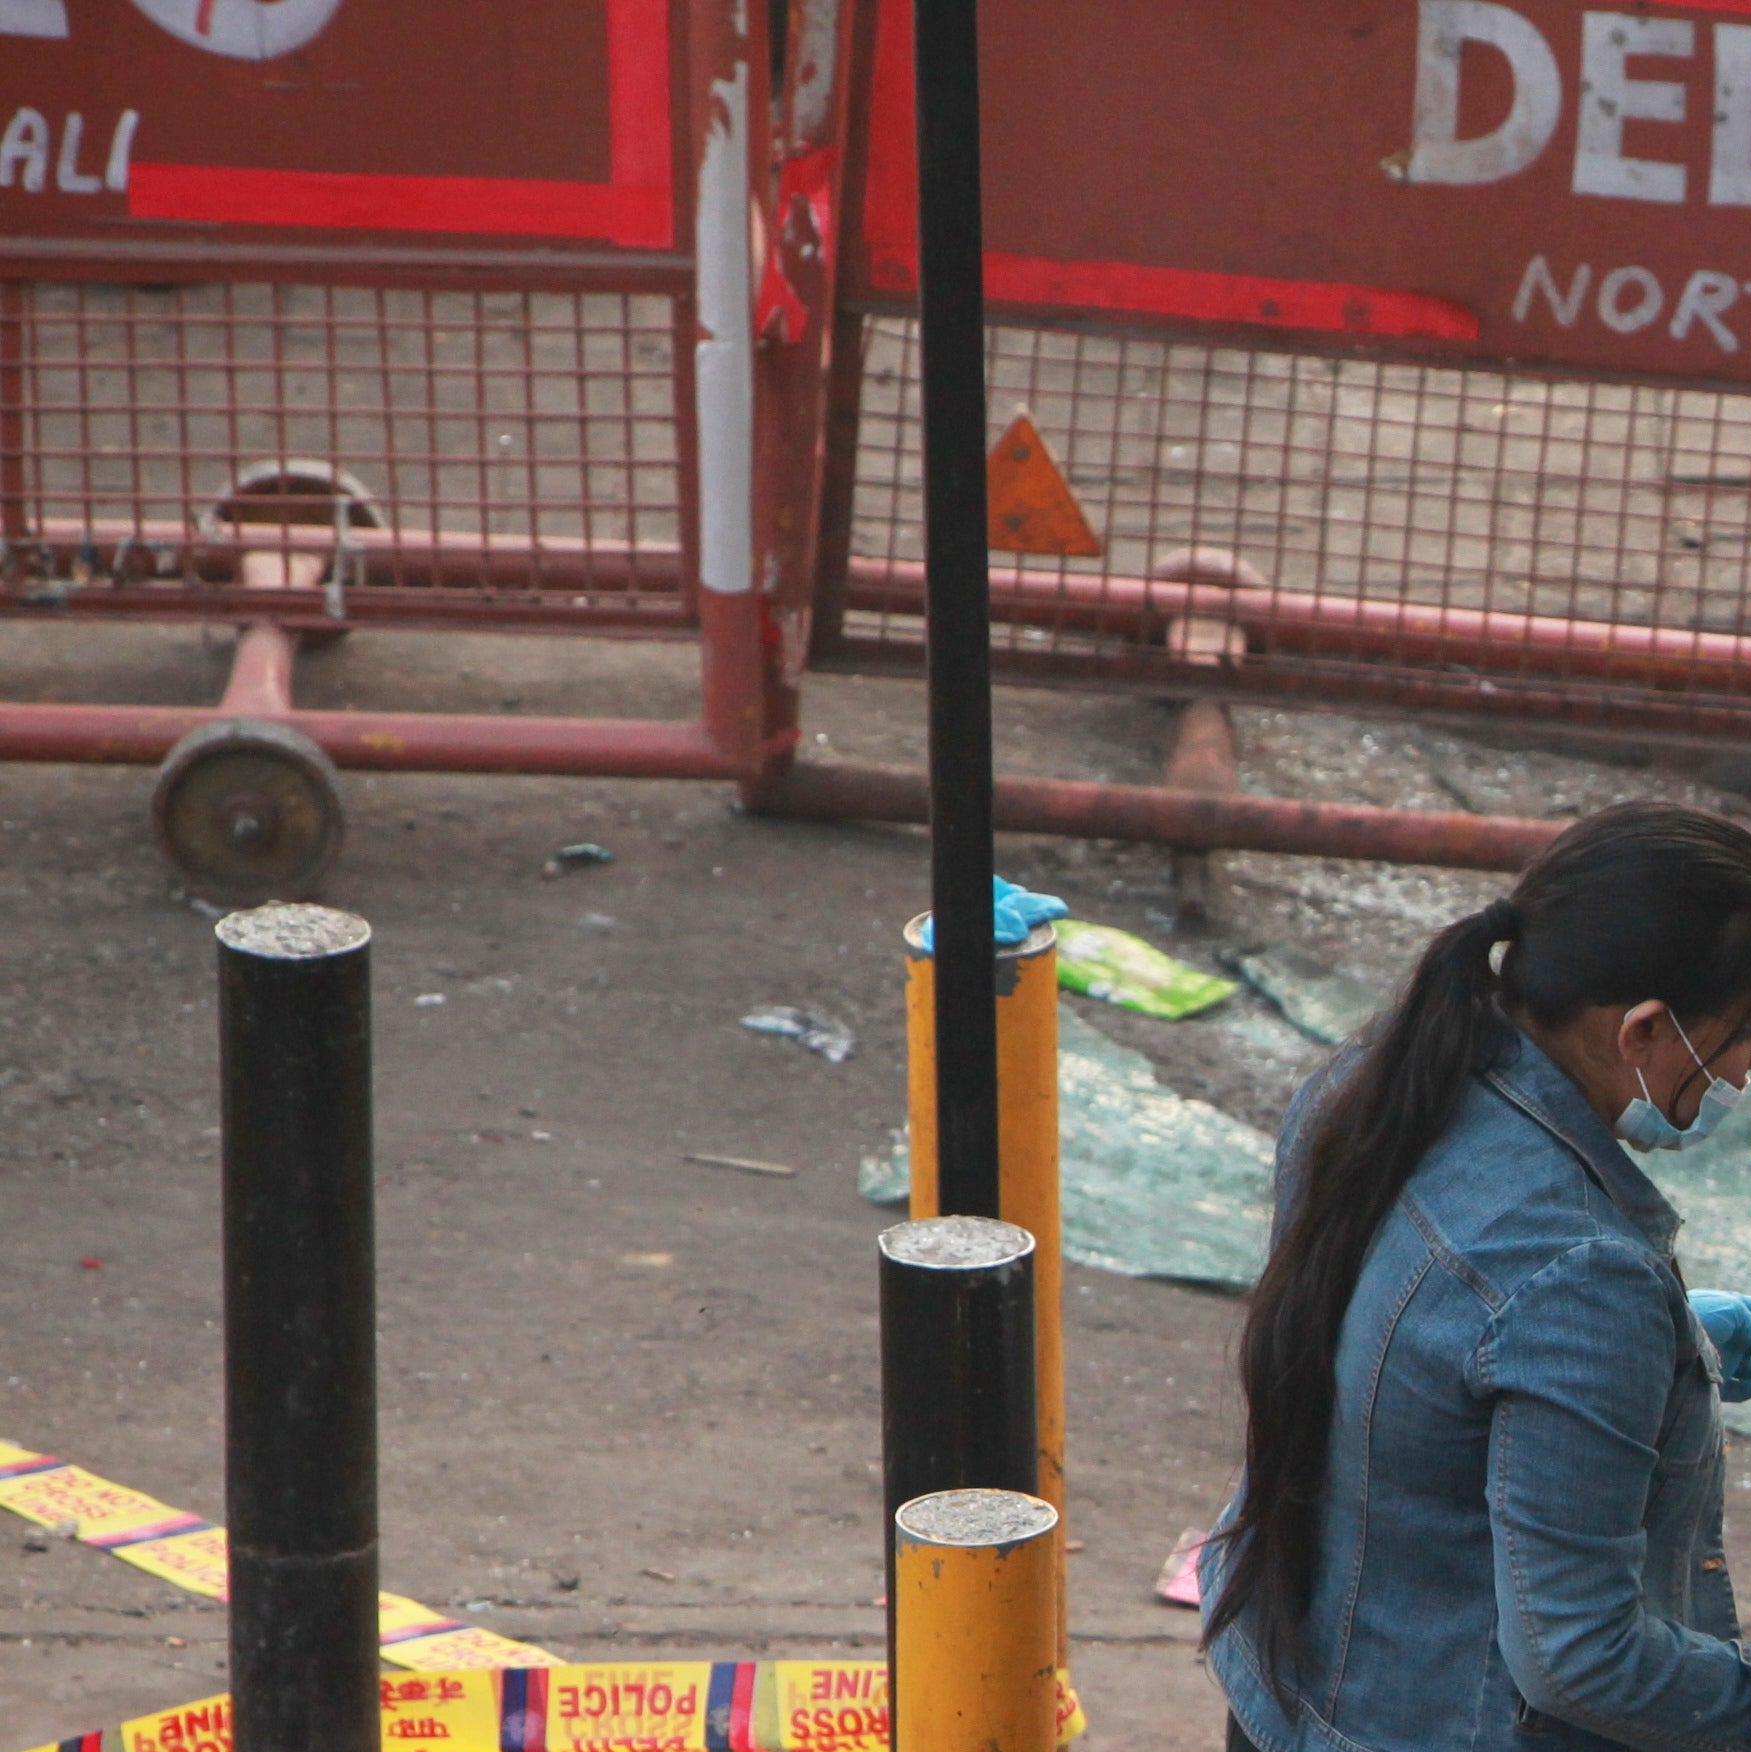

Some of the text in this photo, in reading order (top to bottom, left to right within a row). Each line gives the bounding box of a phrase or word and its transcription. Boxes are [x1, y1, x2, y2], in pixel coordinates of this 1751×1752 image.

[558, 1683, 698, 1718] POLICE
[810, 1668, 889, 1700] INE
[159, 1703, 233, 1746] INE
[790, 1706, 889, 1740] ROSS
